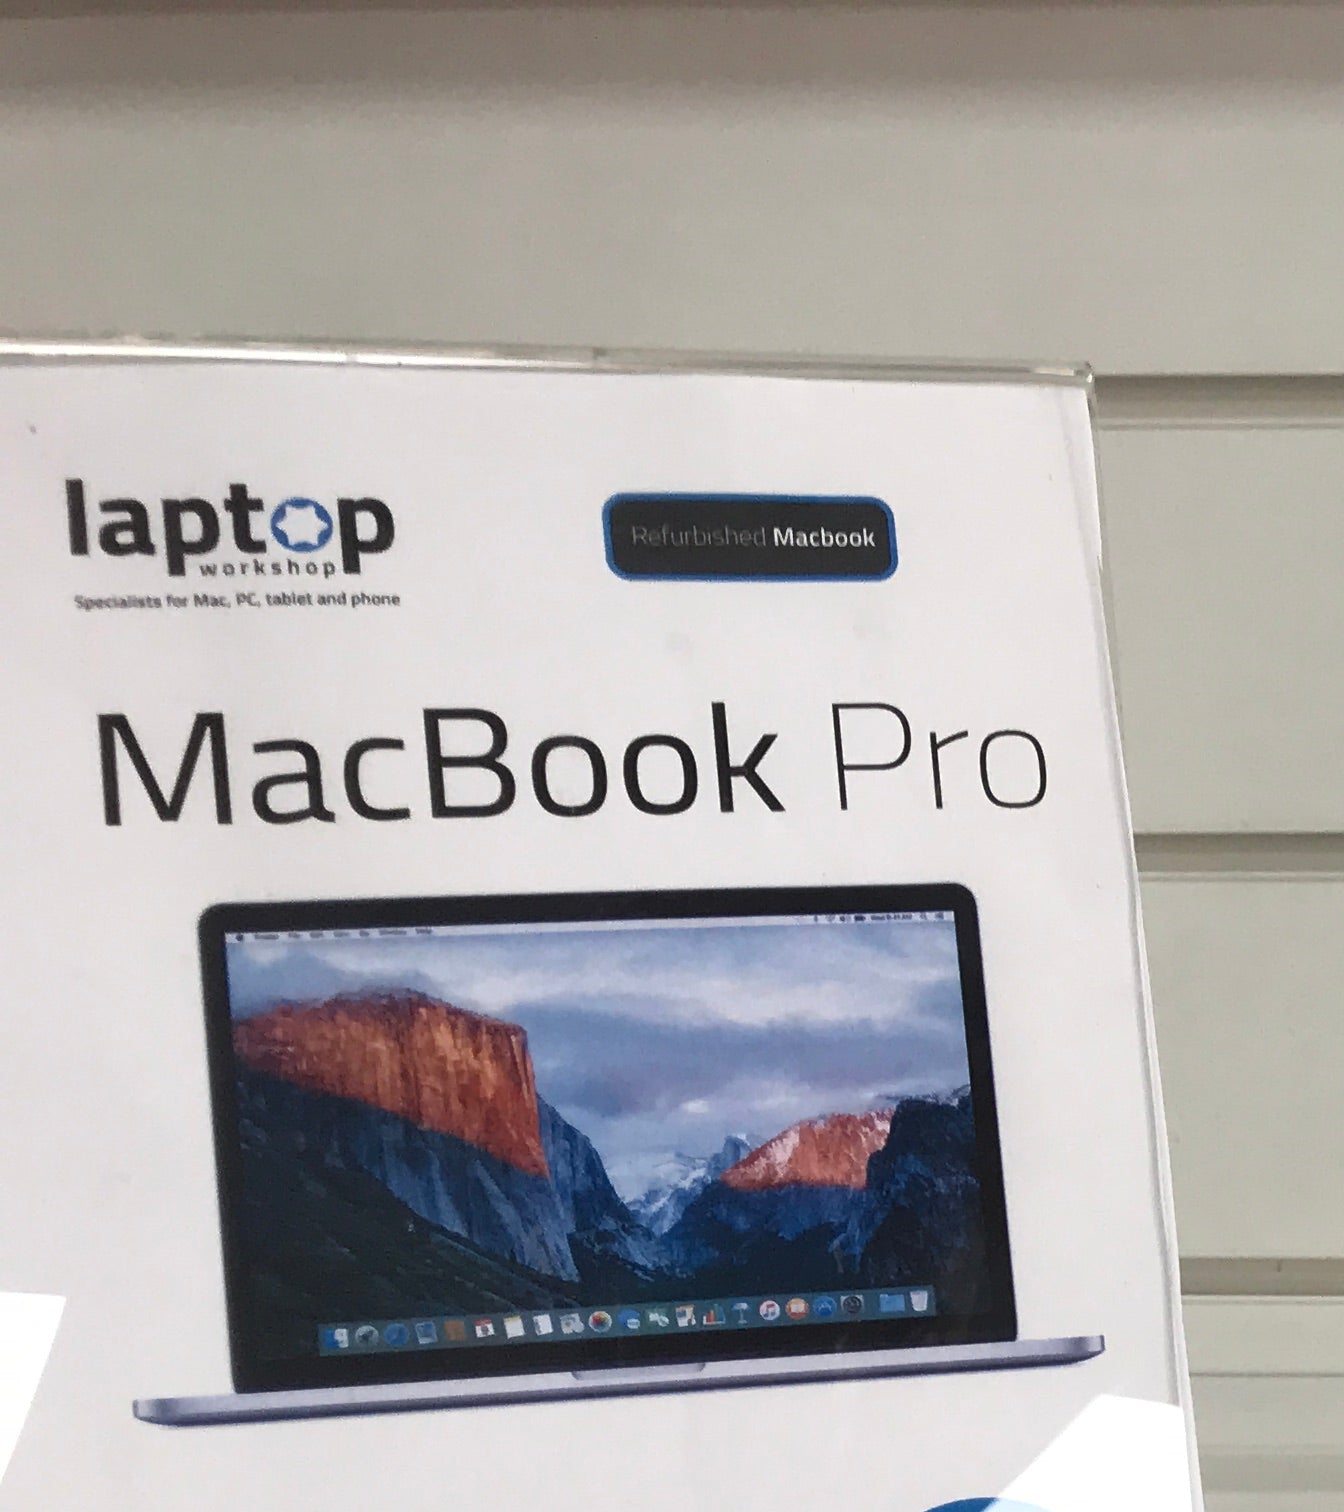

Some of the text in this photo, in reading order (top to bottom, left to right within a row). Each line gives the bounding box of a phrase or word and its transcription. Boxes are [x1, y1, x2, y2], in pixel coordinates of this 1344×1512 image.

[65, 478, 396, 577] laptop
[631, 525, 877, 549] Refurbished Macbook
[200, 559, 336, 578] workshop
[74, 590, 400, 610] Specialists for Mac, PC, tablet and phone
[97, 702, 1046, 826] MacBook Pro
